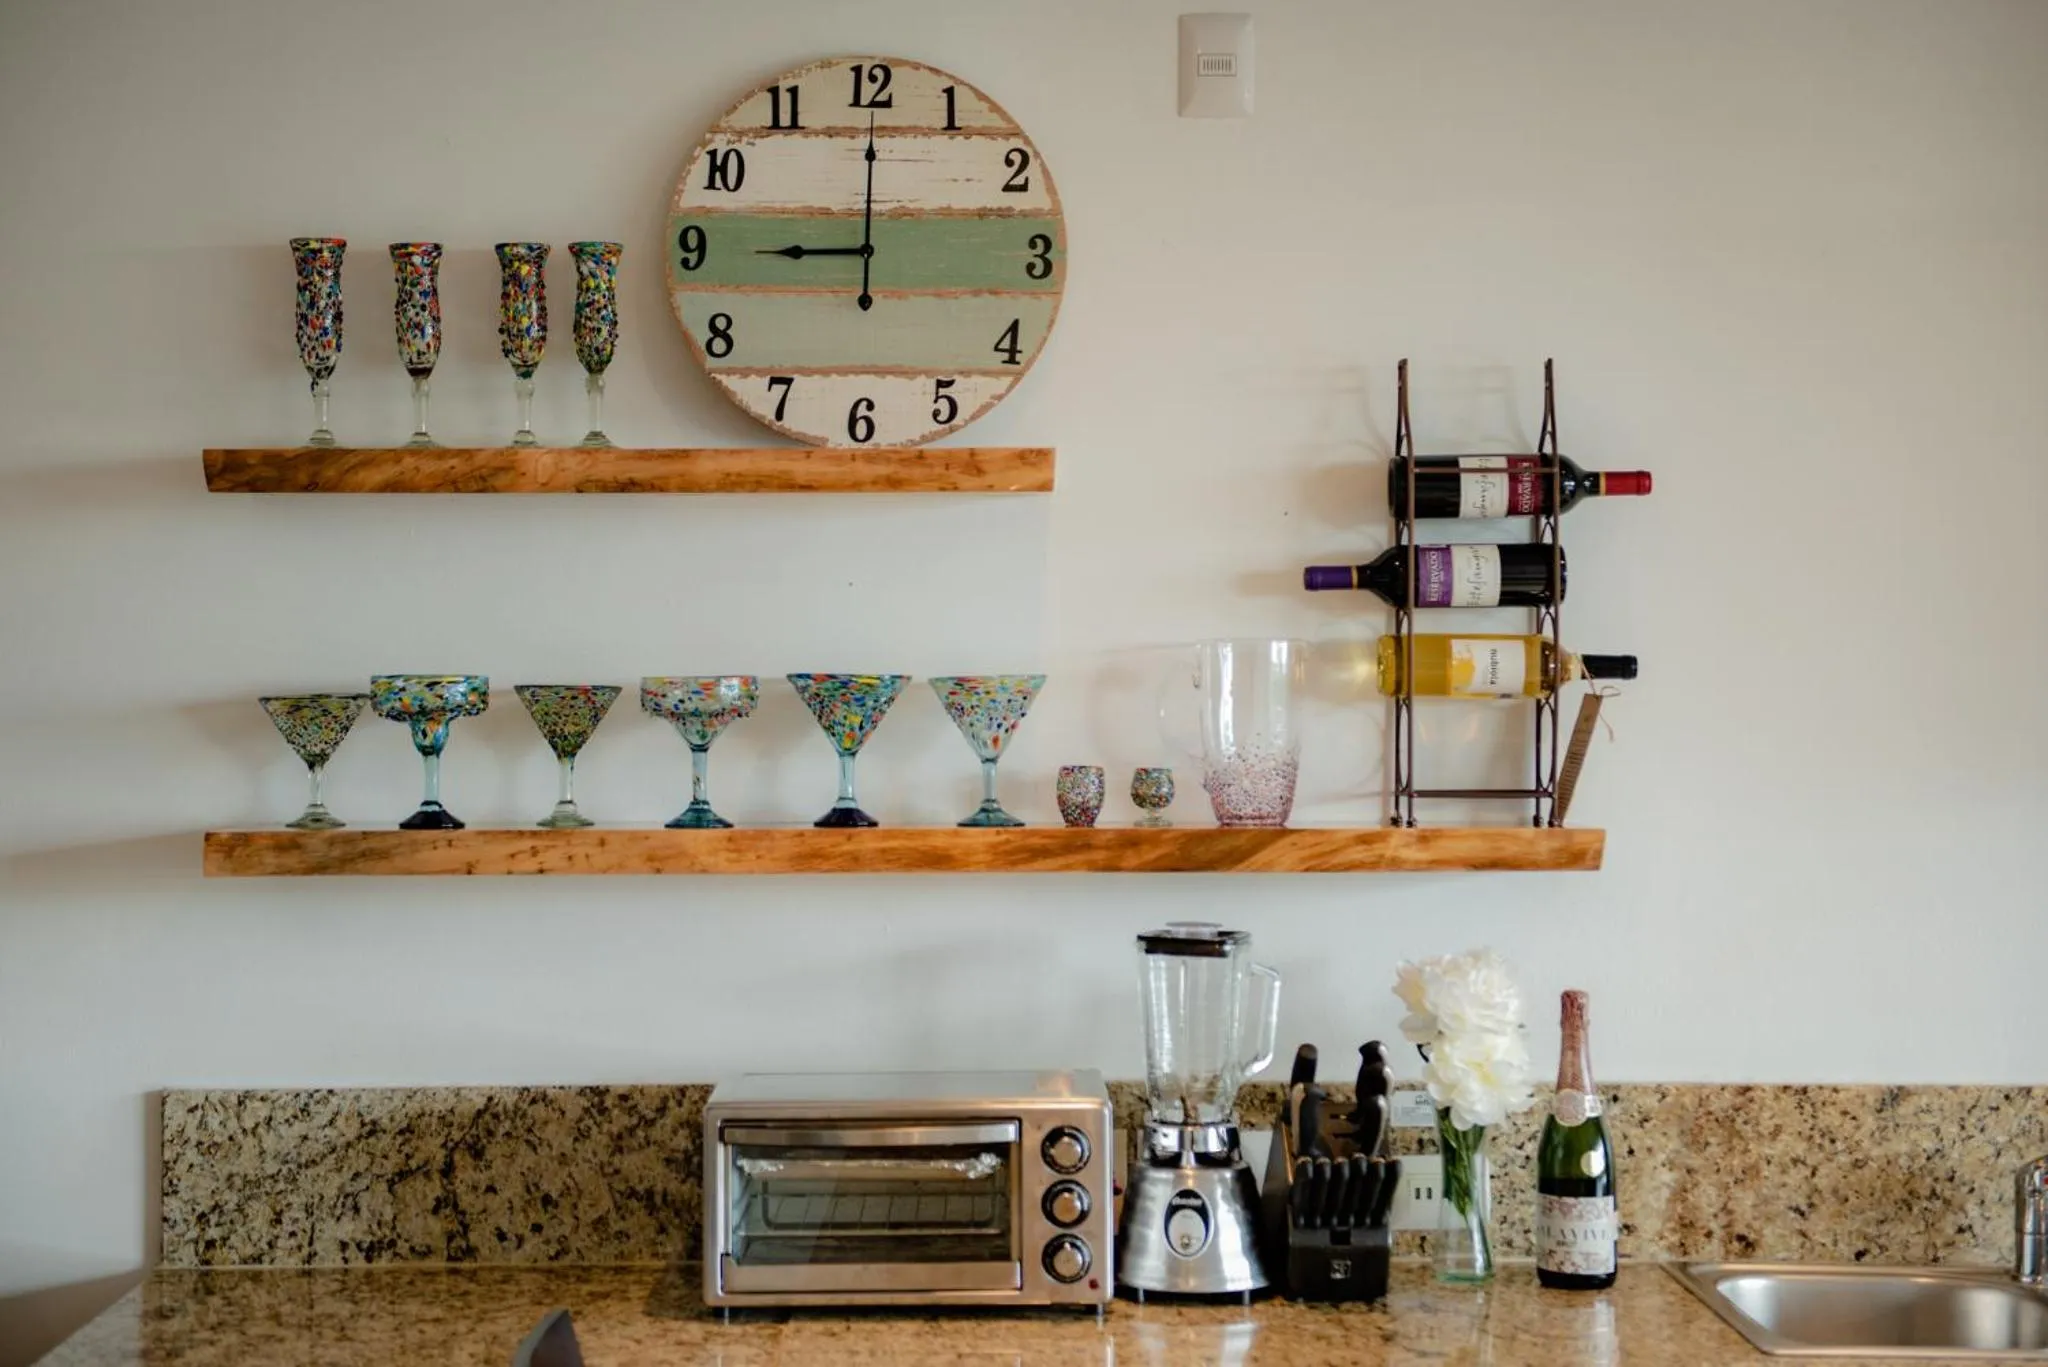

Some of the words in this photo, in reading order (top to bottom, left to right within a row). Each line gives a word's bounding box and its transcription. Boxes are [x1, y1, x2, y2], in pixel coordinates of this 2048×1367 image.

[767, 85, 806, 130] 11
[848, 63, 893, 109] 12
[941, 85, 963, 131] 1
[703, 148, 745, 193] 10
[1001, 147, 1030, 193] 2
[677, 224, 708, 271] 9
[1025, 233, 1053, 280] 3
[705, 312, 734, 359] 8
[993, 318, 1023, 366] 4
[767, 375, 795, 423] 7
[847, 397, 876, 443] 6
[932, 378, 959, 425] 5
[1522, 461, 1533, 513] RSERVADO
